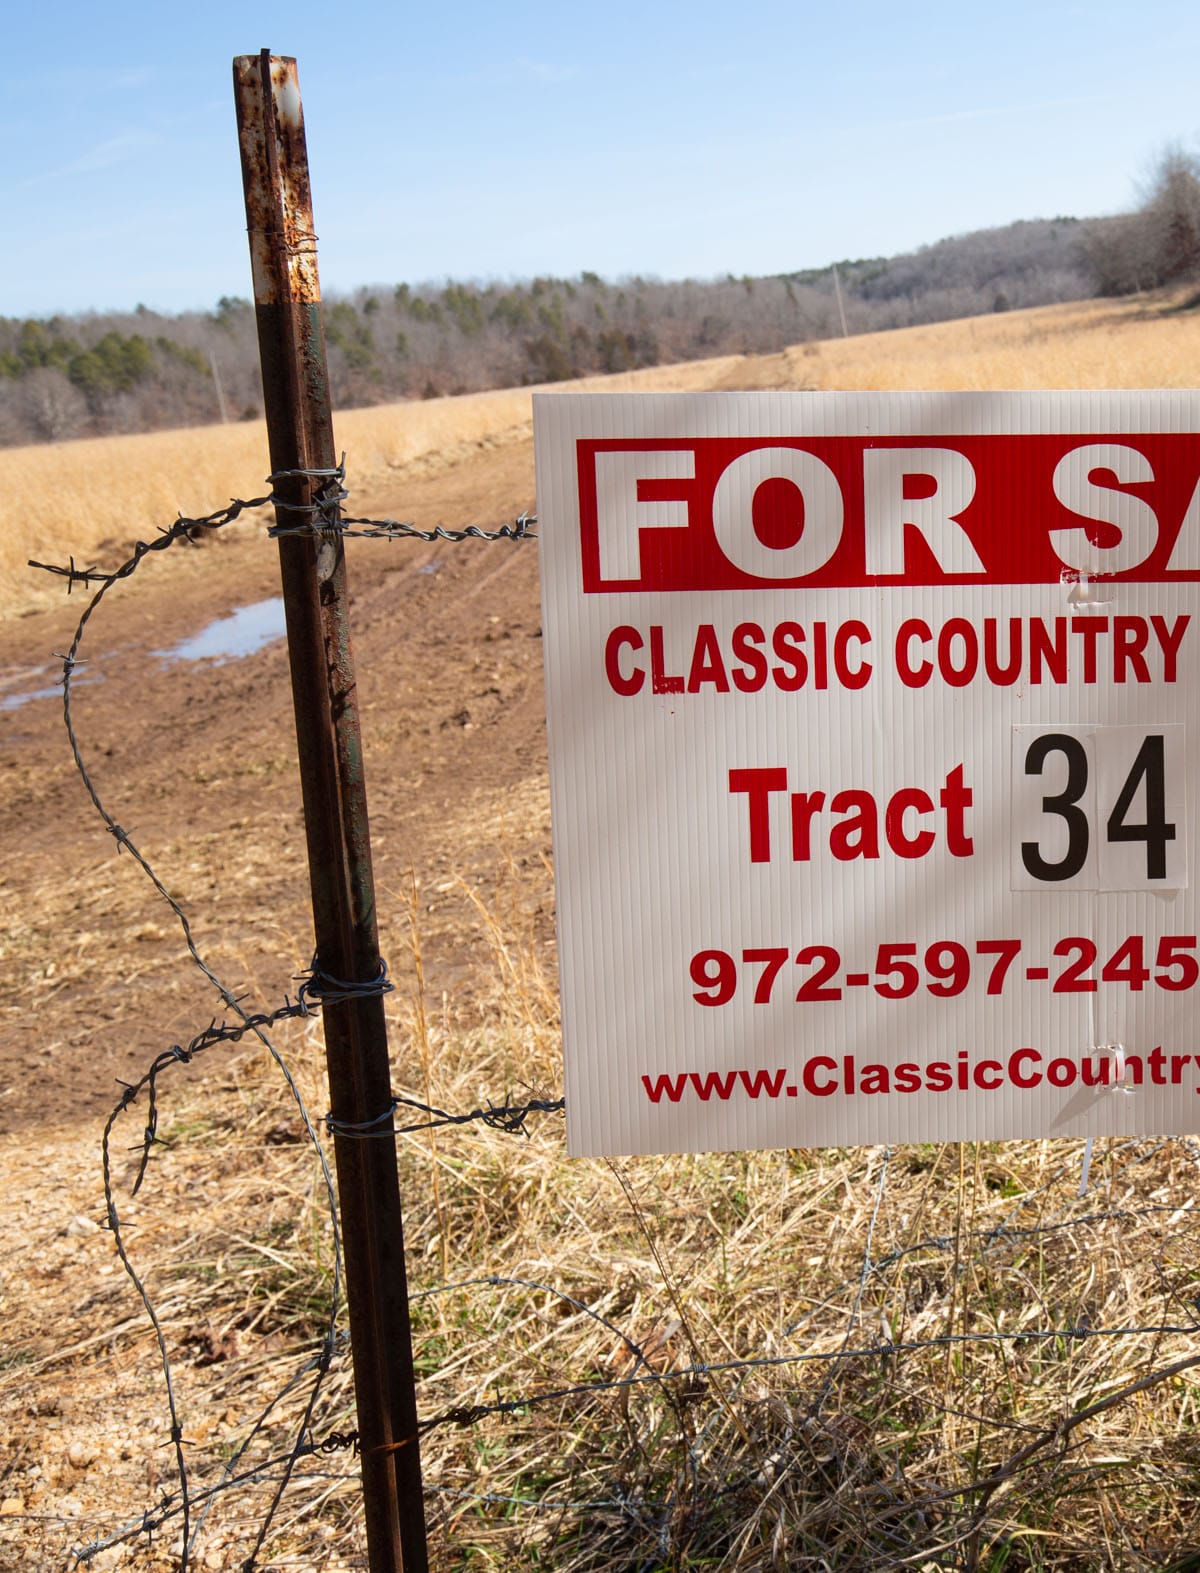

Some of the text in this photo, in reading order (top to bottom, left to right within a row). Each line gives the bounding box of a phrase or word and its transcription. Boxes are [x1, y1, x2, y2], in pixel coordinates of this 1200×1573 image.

[594, 447, 986, 581] FOR
[604, 619, 873, 697] CLASSIC
[894, 615, 1192, 688] COUNTRY
[727, 733, 1176, 882] Tract 34
